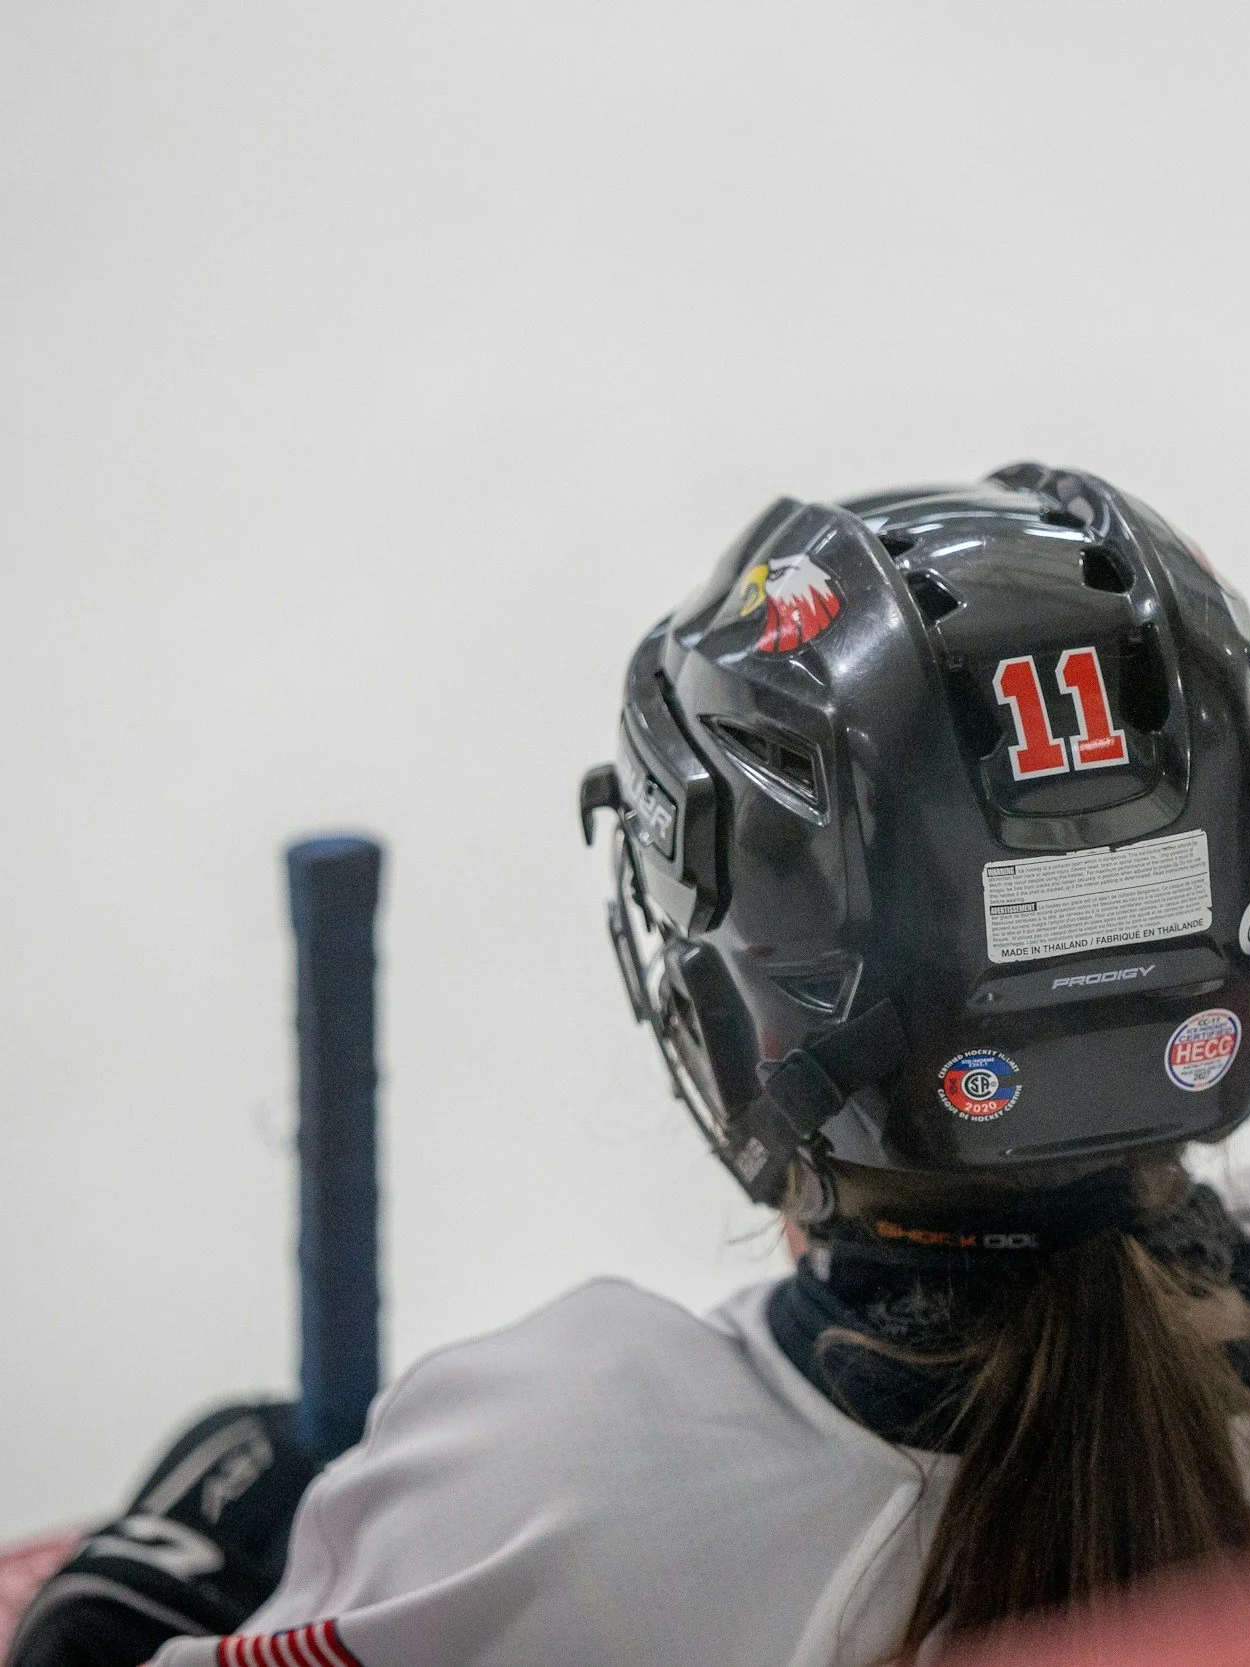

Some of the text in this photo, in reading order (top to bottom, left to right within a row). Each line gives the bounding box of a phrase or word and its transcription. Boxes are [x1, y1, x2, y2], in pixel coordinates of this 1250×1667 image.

[992, 646, 1130, 781] 11
[1001, 947, 1028, 957] MADE
[1030, 945, 1040, 954] IN
[1042, 939, 1088, 952] THAILAND
[1095, 929, 1140, 944] FABRIQUÉ
[1142, 928, 1154, 937] EN
[1156, 917, 1203, 935] THAÏLANDE
[1052, 965, 1156, 990] PRODIGY
[964, 1049, 998, 1057] HOCKEY
[937, 1088, 958, 1115] CASQUE
[959, 1111, 969, 1120] DE
[971, 1110, 1004, 1122] HOCKEY
[964, 1101, 997, 1113] 2020
